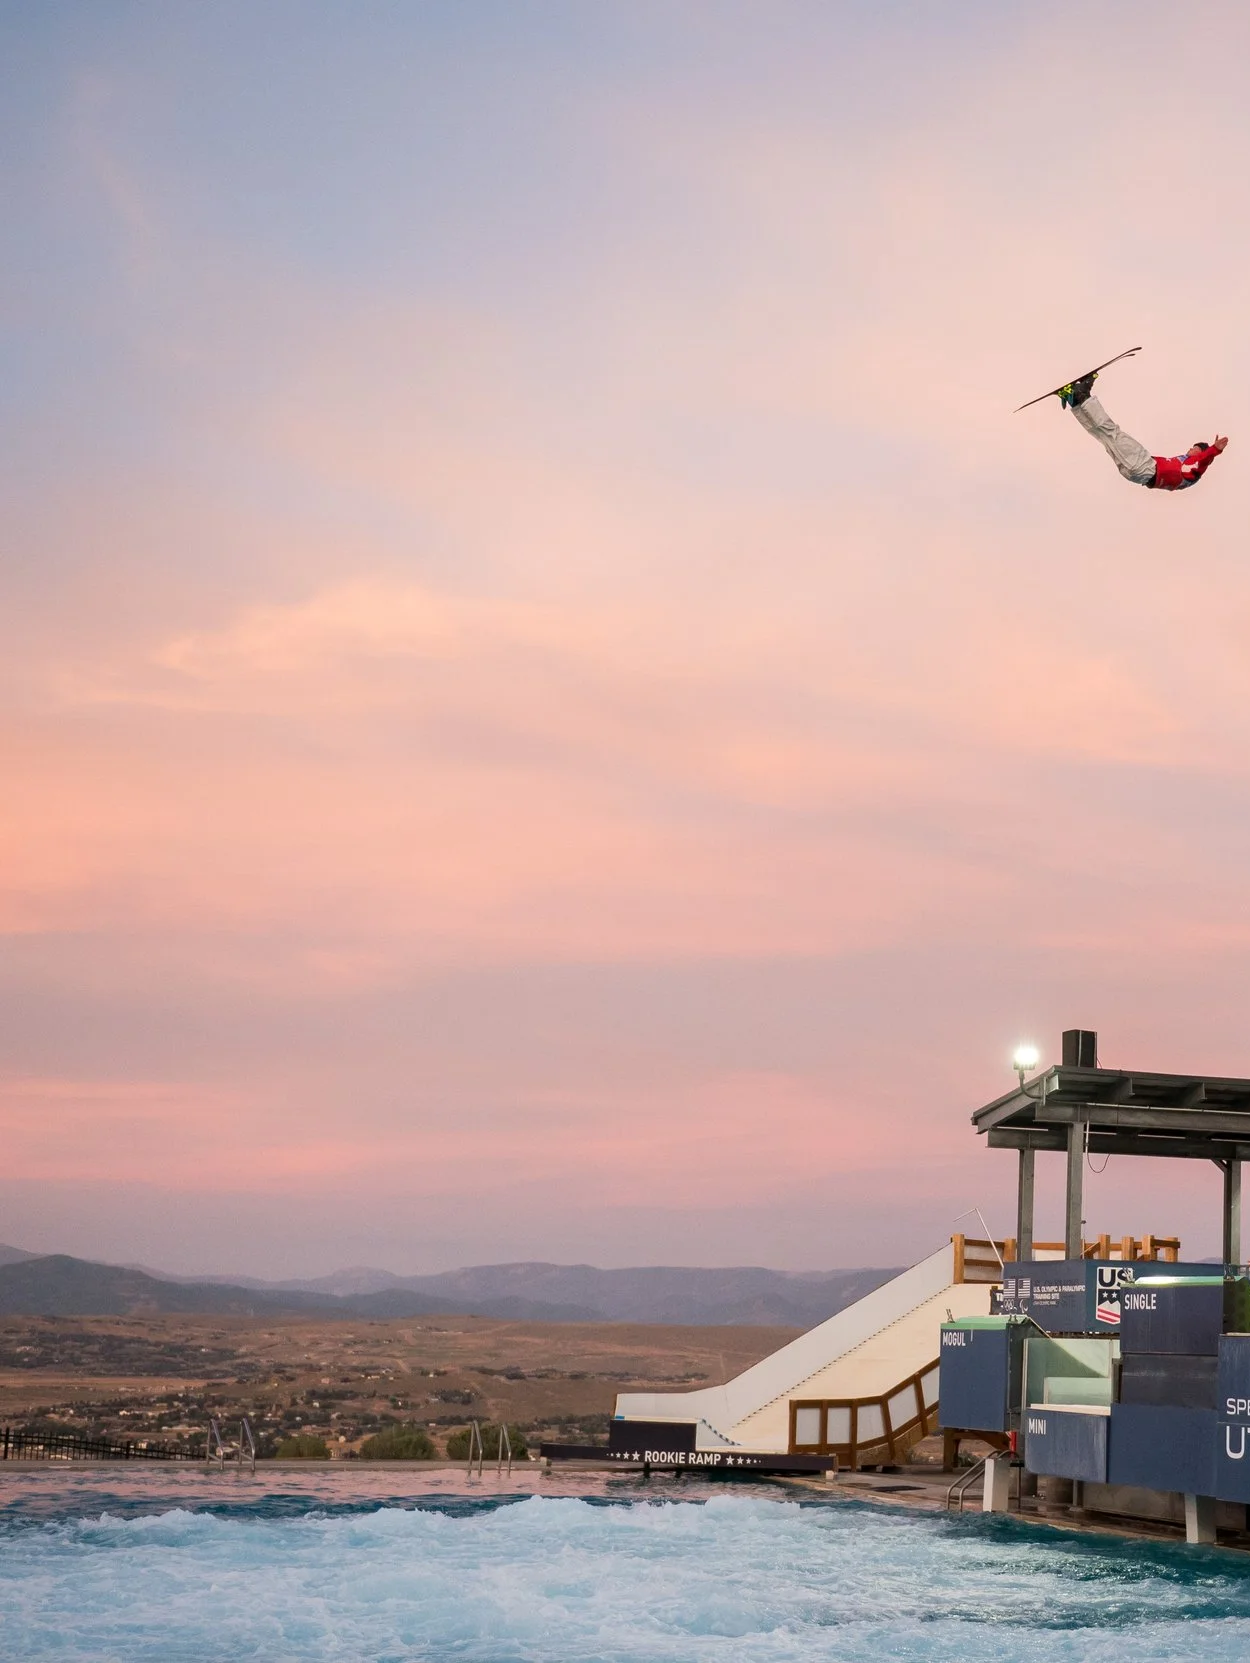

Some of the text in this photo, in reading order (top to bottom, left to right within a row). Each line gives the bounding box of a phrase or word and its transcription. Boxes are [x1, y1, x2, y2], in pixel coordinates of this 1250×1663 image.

[1041, 1285, 1058, 1293] OLYMPIC
[1062, 1284, 1086, 1292] PARALYMPIC
[1051, 1292, 1060, 1300] SITE
[1124, 1293, 1157, 1310] SINGLE
[942, 1332, 966, 1347] MOGUL
[1028, 1418, 1047, 1435] MINI
[644, 1450, 722, 1466] ROOKIE RAMP
